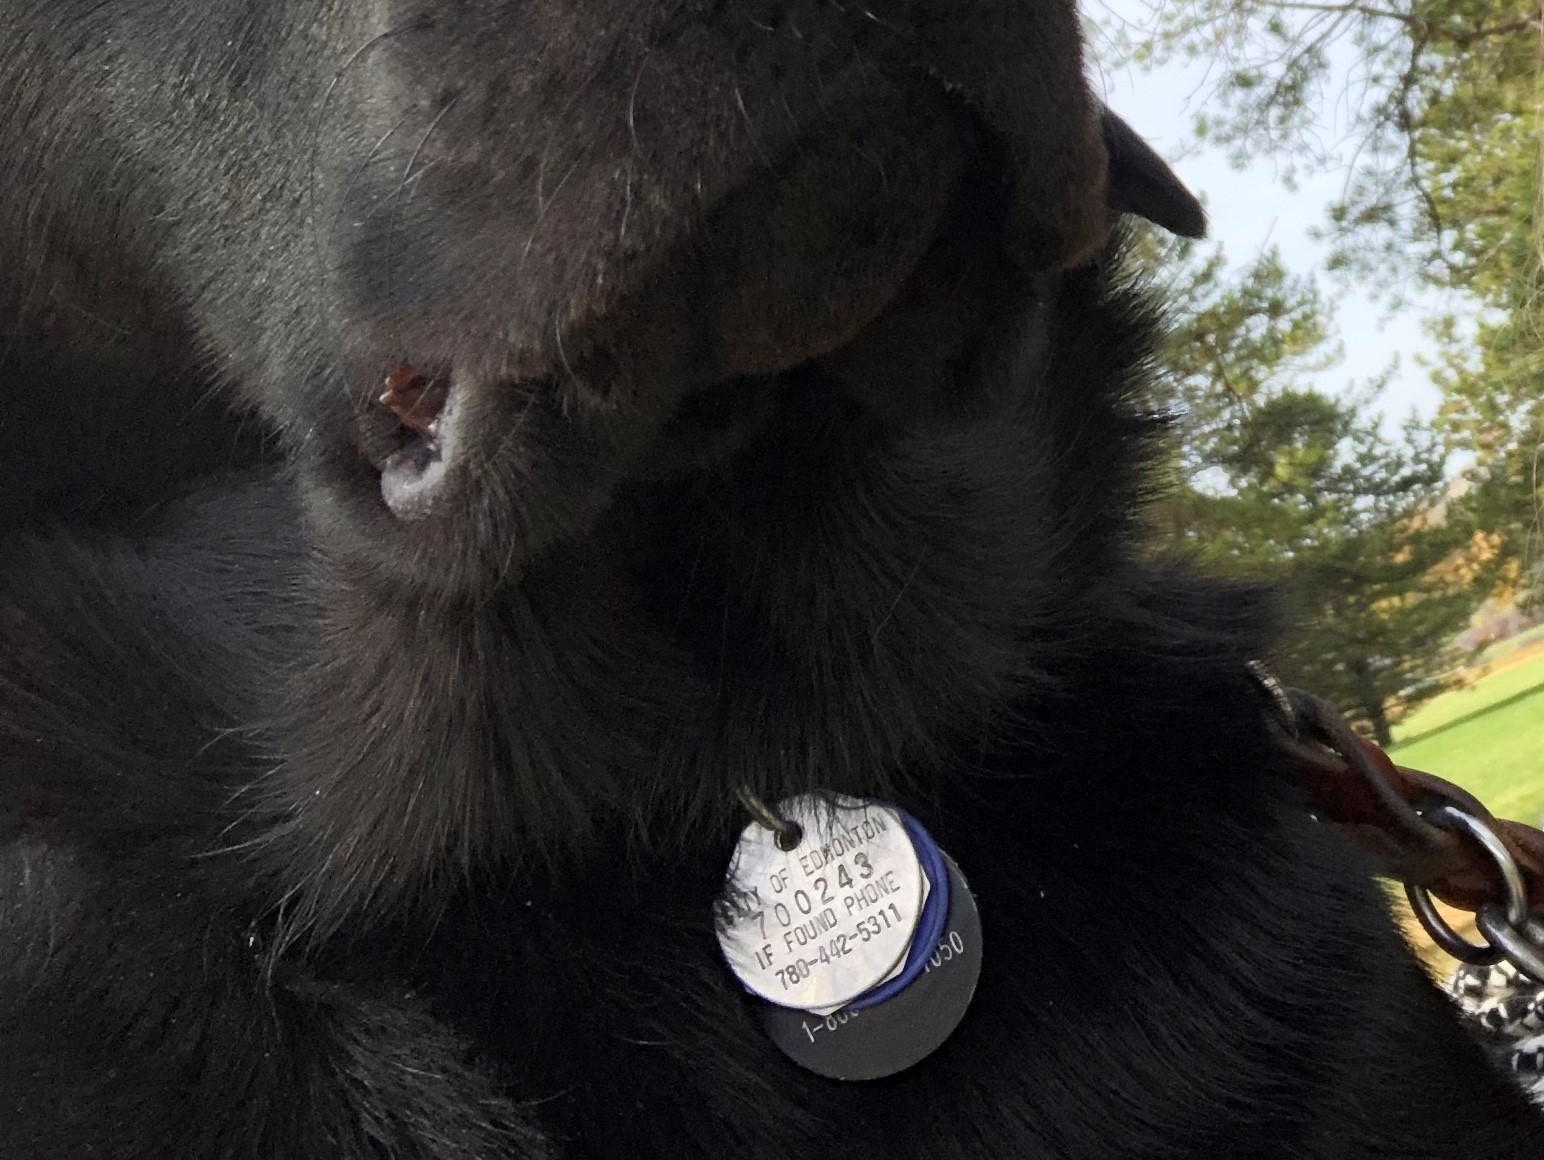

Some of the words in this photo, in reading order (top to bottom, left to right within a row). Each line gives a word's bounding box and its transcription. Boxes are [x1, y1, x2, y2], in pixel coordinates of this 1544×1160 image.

[770, 868, 788, 893] OF
[799, 814, 887, 876] EDMONTON
[754, 943, 773, 970] IF
[783, 907, 837, 952] FOUND
[844, 870, 900, 916] PHONE
[775, 902, 901, 990] 780-442-5311
